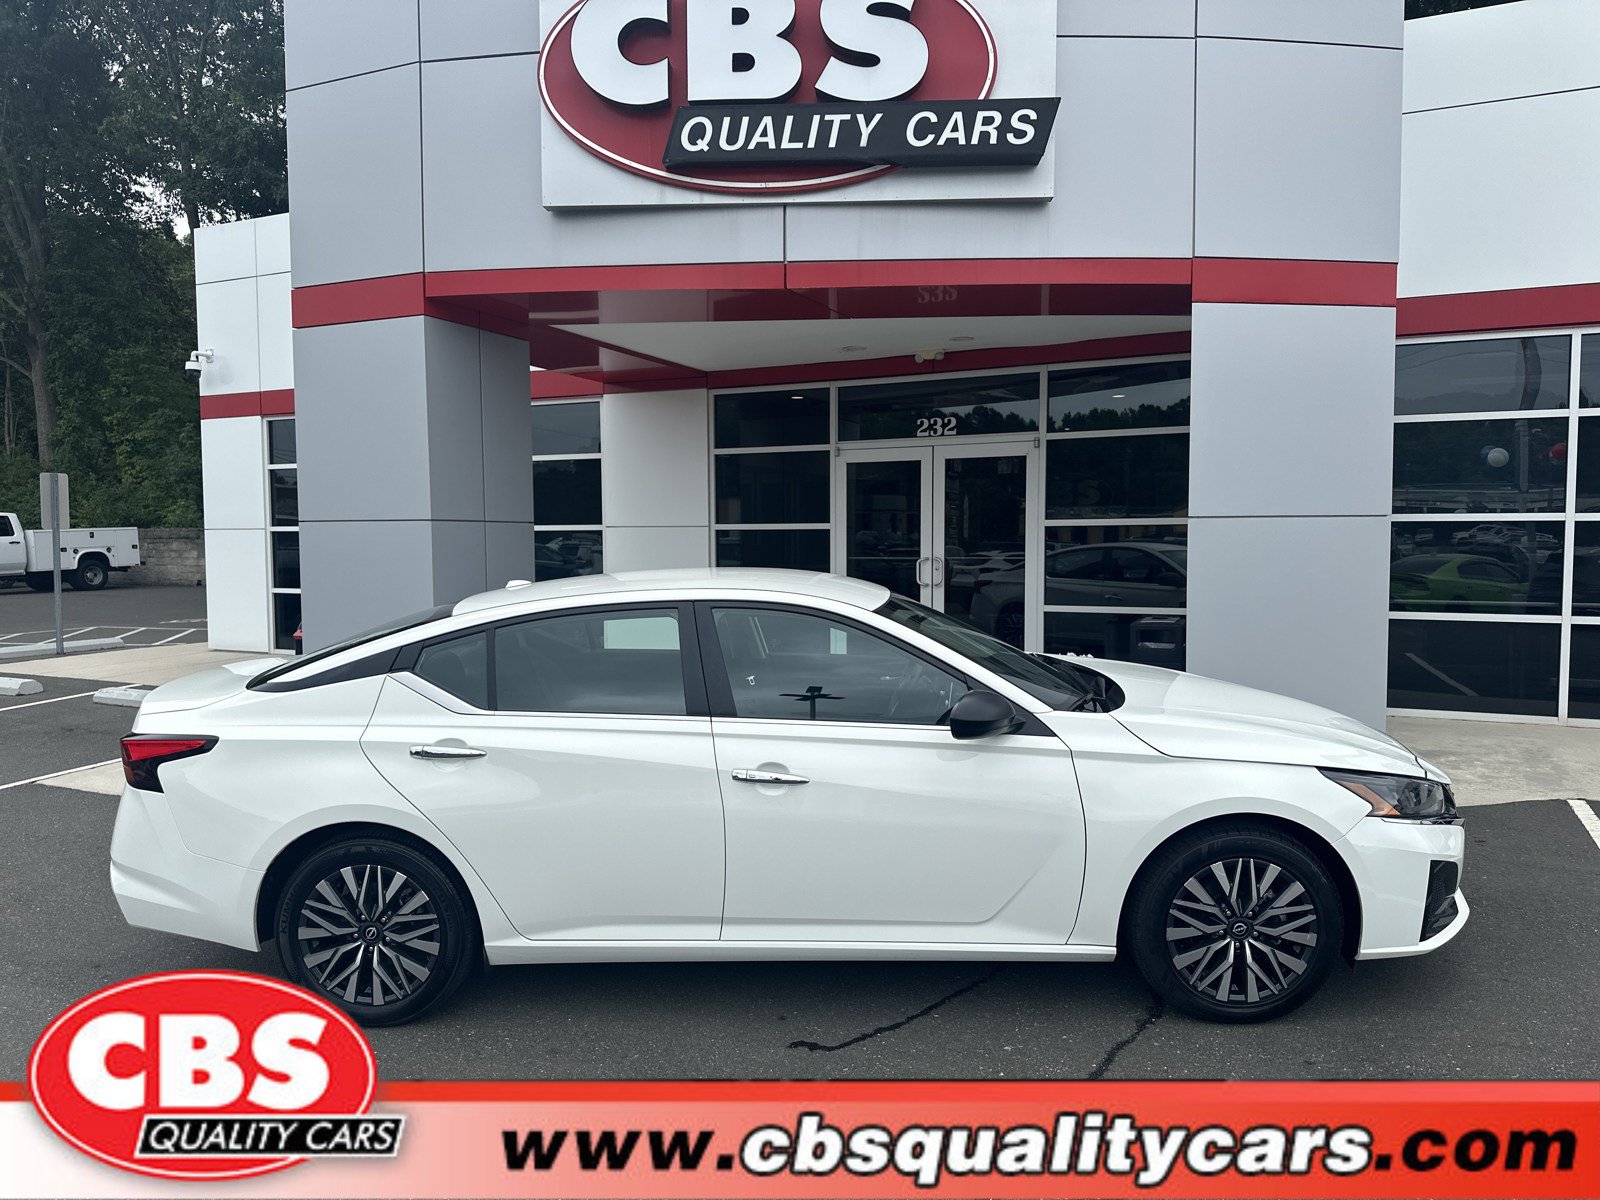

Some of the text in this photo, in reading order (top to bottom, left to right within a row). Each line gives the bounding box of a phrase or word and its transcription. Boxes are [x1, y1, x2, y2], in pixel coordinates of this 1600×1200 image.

[570, 0, 929, 105] CBS
[680, 109, 1038, 152] QUALITY CARS
[916, 416, 957, 437] 232
